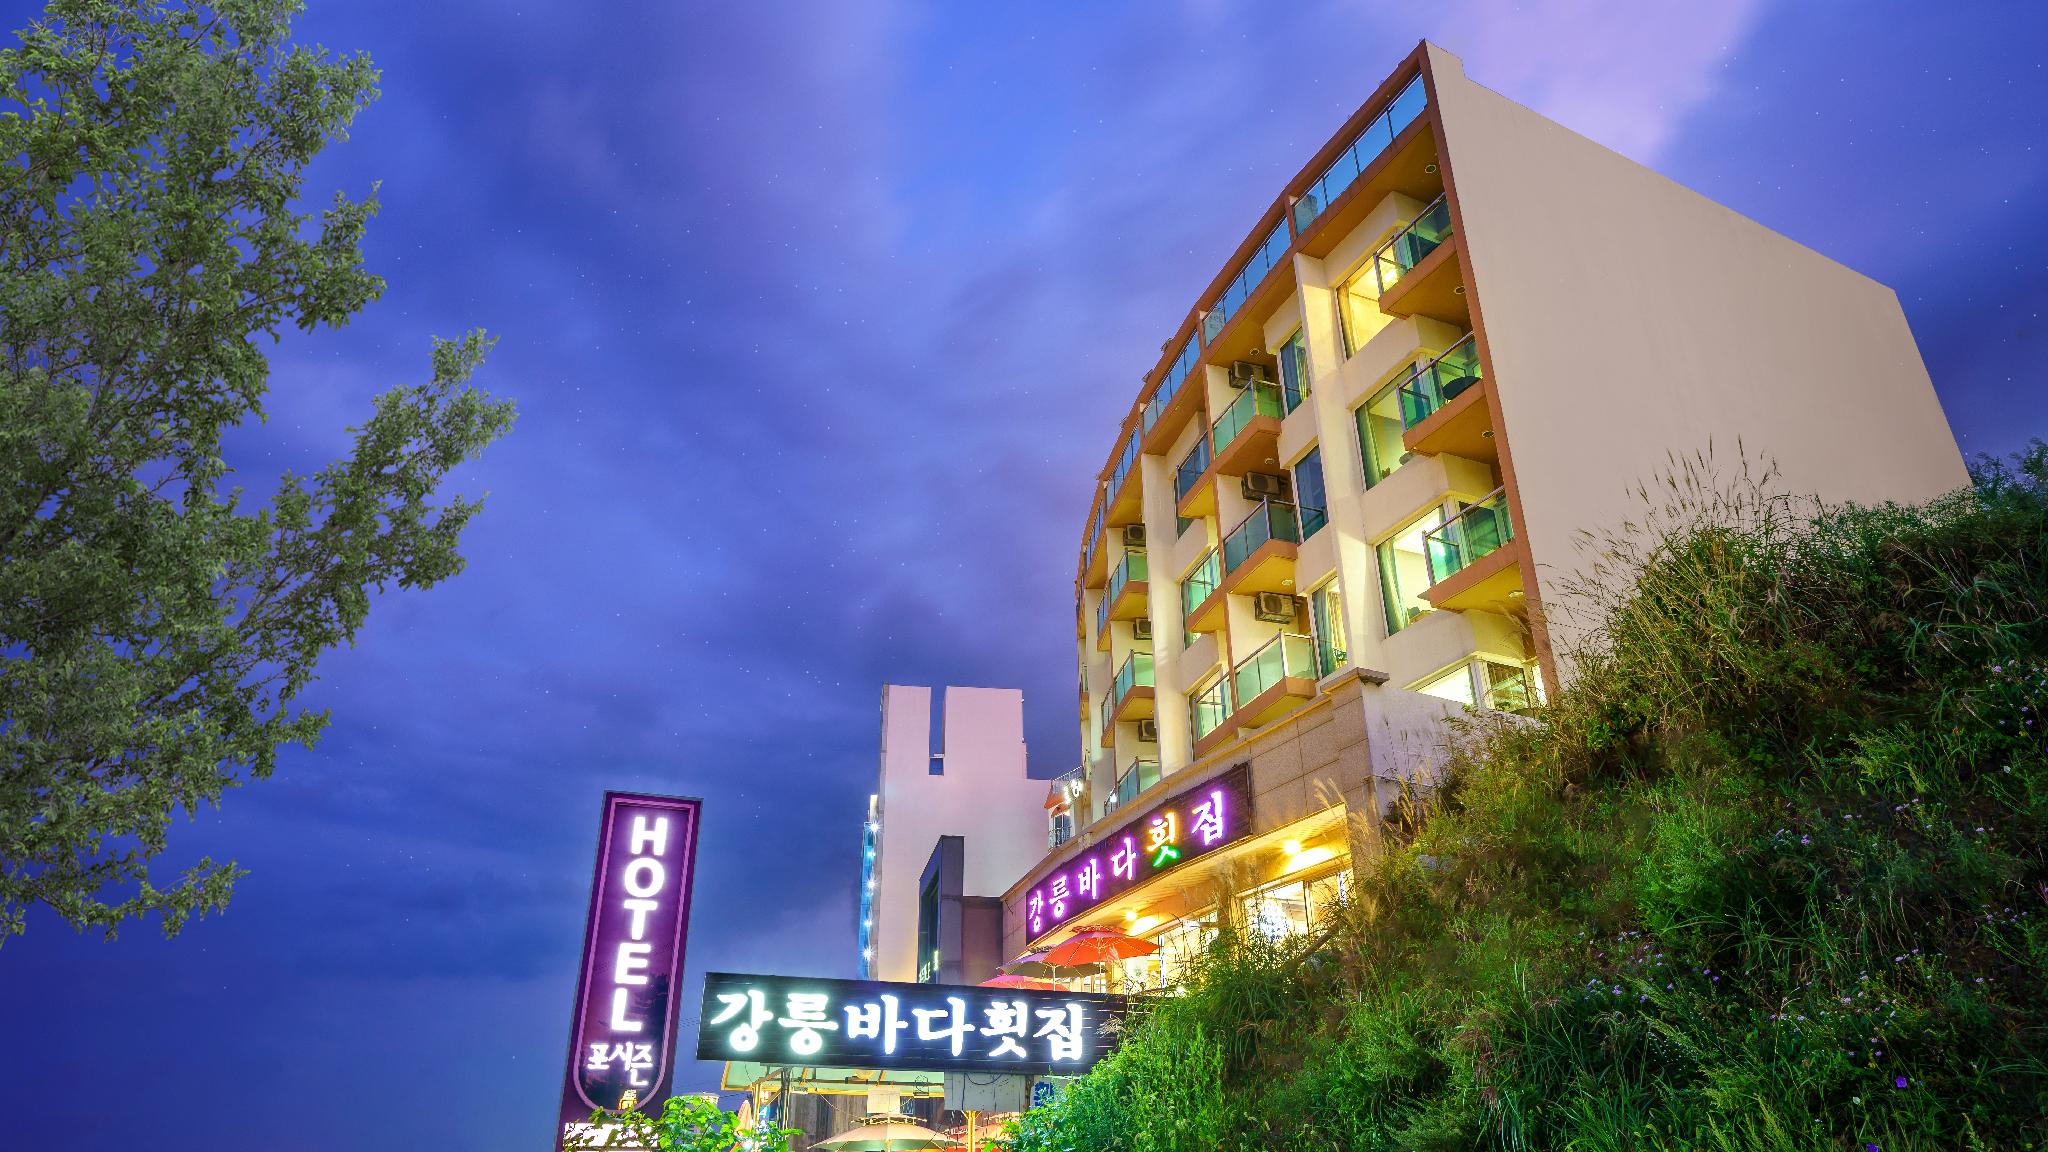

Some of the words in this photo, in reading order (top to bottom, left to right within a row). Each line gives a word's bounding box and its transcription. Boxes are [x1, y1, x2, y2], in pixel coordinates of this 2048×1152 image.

[1028, 791, 1226, 933] 강릉바다횟집
[611, 816, 668, 1032] HOTEL
[587, 1041, 653, 1086] 포시즌
[711, 989, 1083, 1060] 강릉바다횟집
